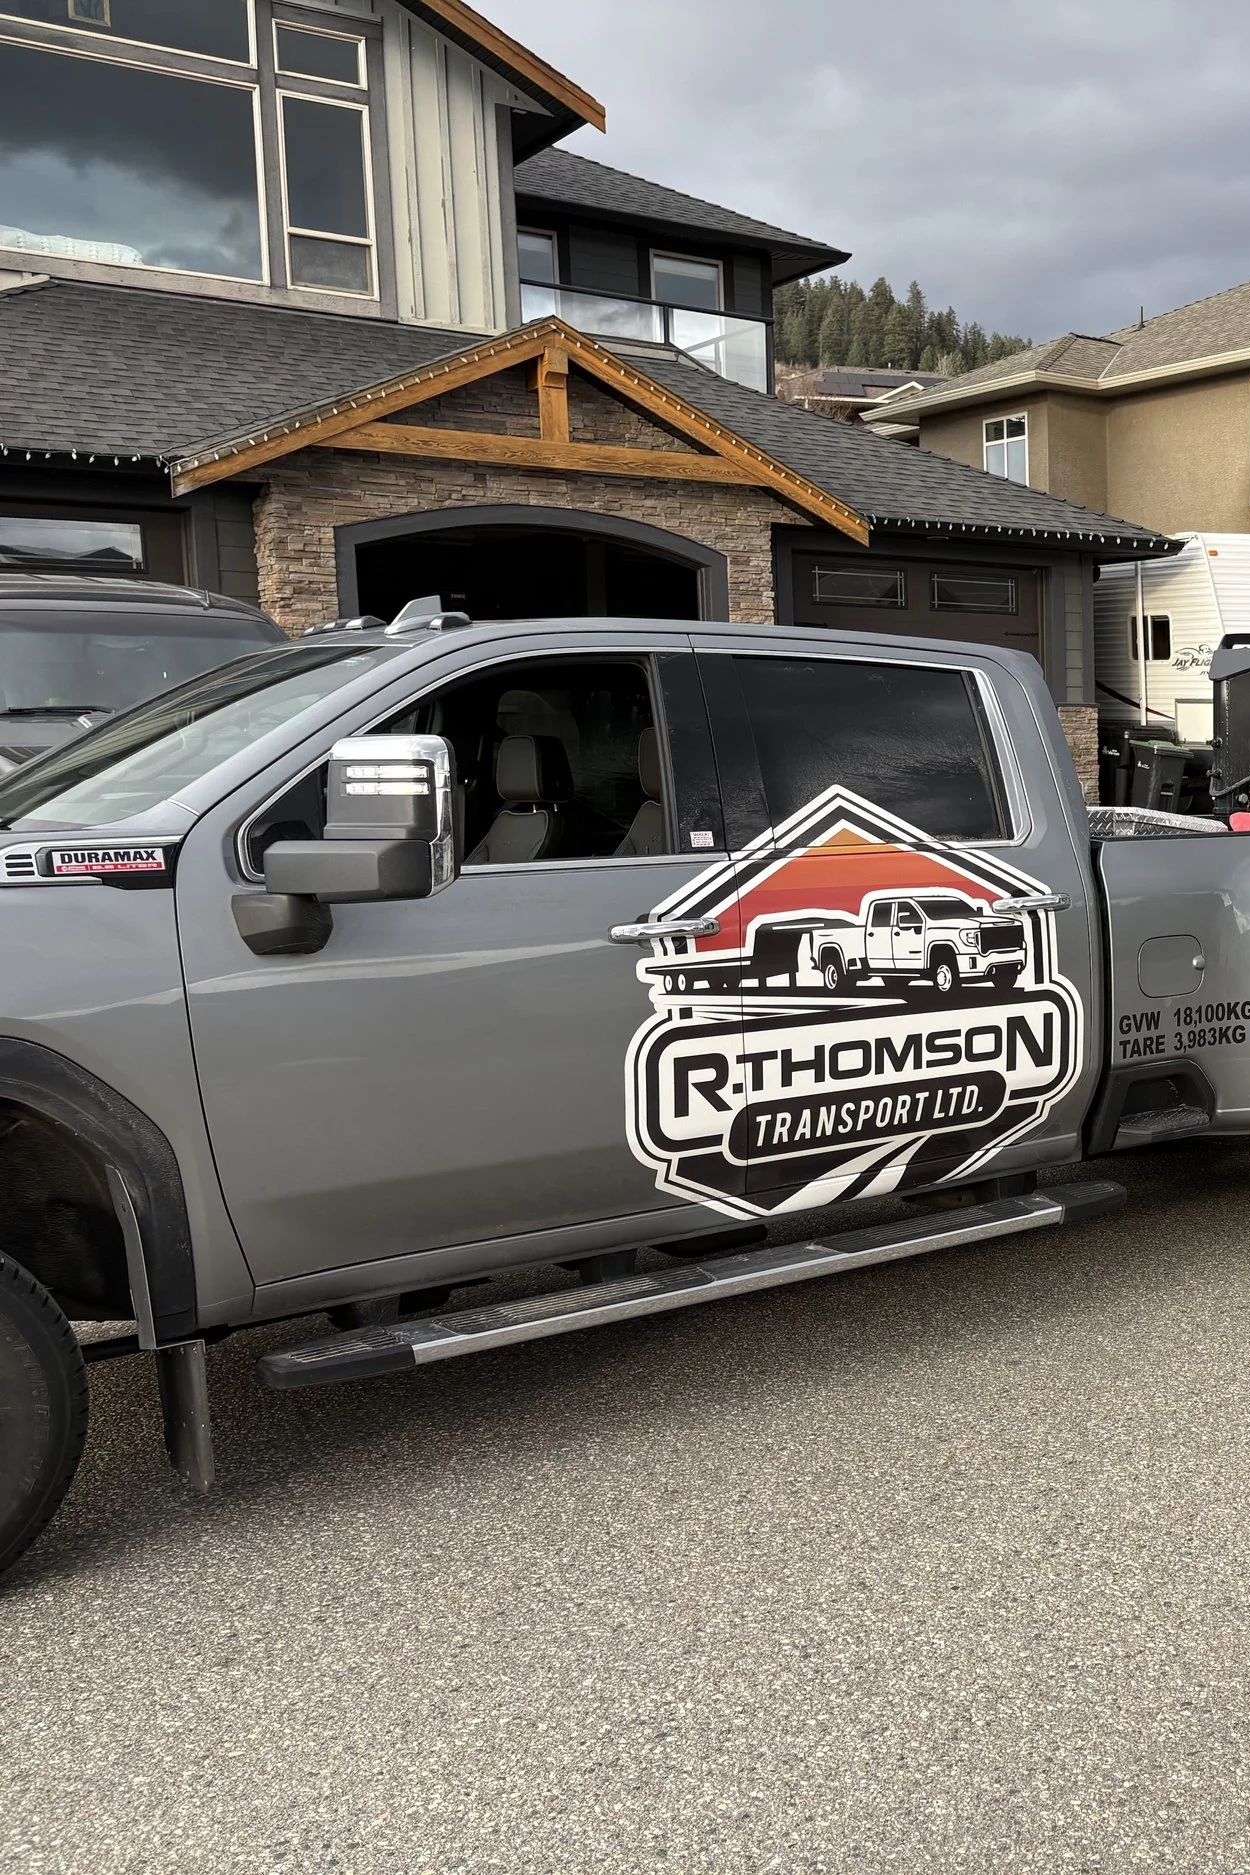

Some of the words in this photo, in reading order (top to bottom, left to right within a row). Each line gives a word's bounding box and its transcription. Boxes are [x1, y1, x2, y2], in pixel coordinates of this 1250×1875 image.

[1190, 658, 1211, 666] FLIG
[60, 850, 157, 864] DURAMAX
[1119, 1010, 1161, 1034] GVW
[1119, 1034, 1165, 1059] TARE
[1173, 1025, 1246, 1053] 3,983KG
[673, 1012, 1054, 1119] R.THOMSON
[754, 1096, 925, 1148] TRANSPORT
[932, 1084, 985, 1120] LTD.
